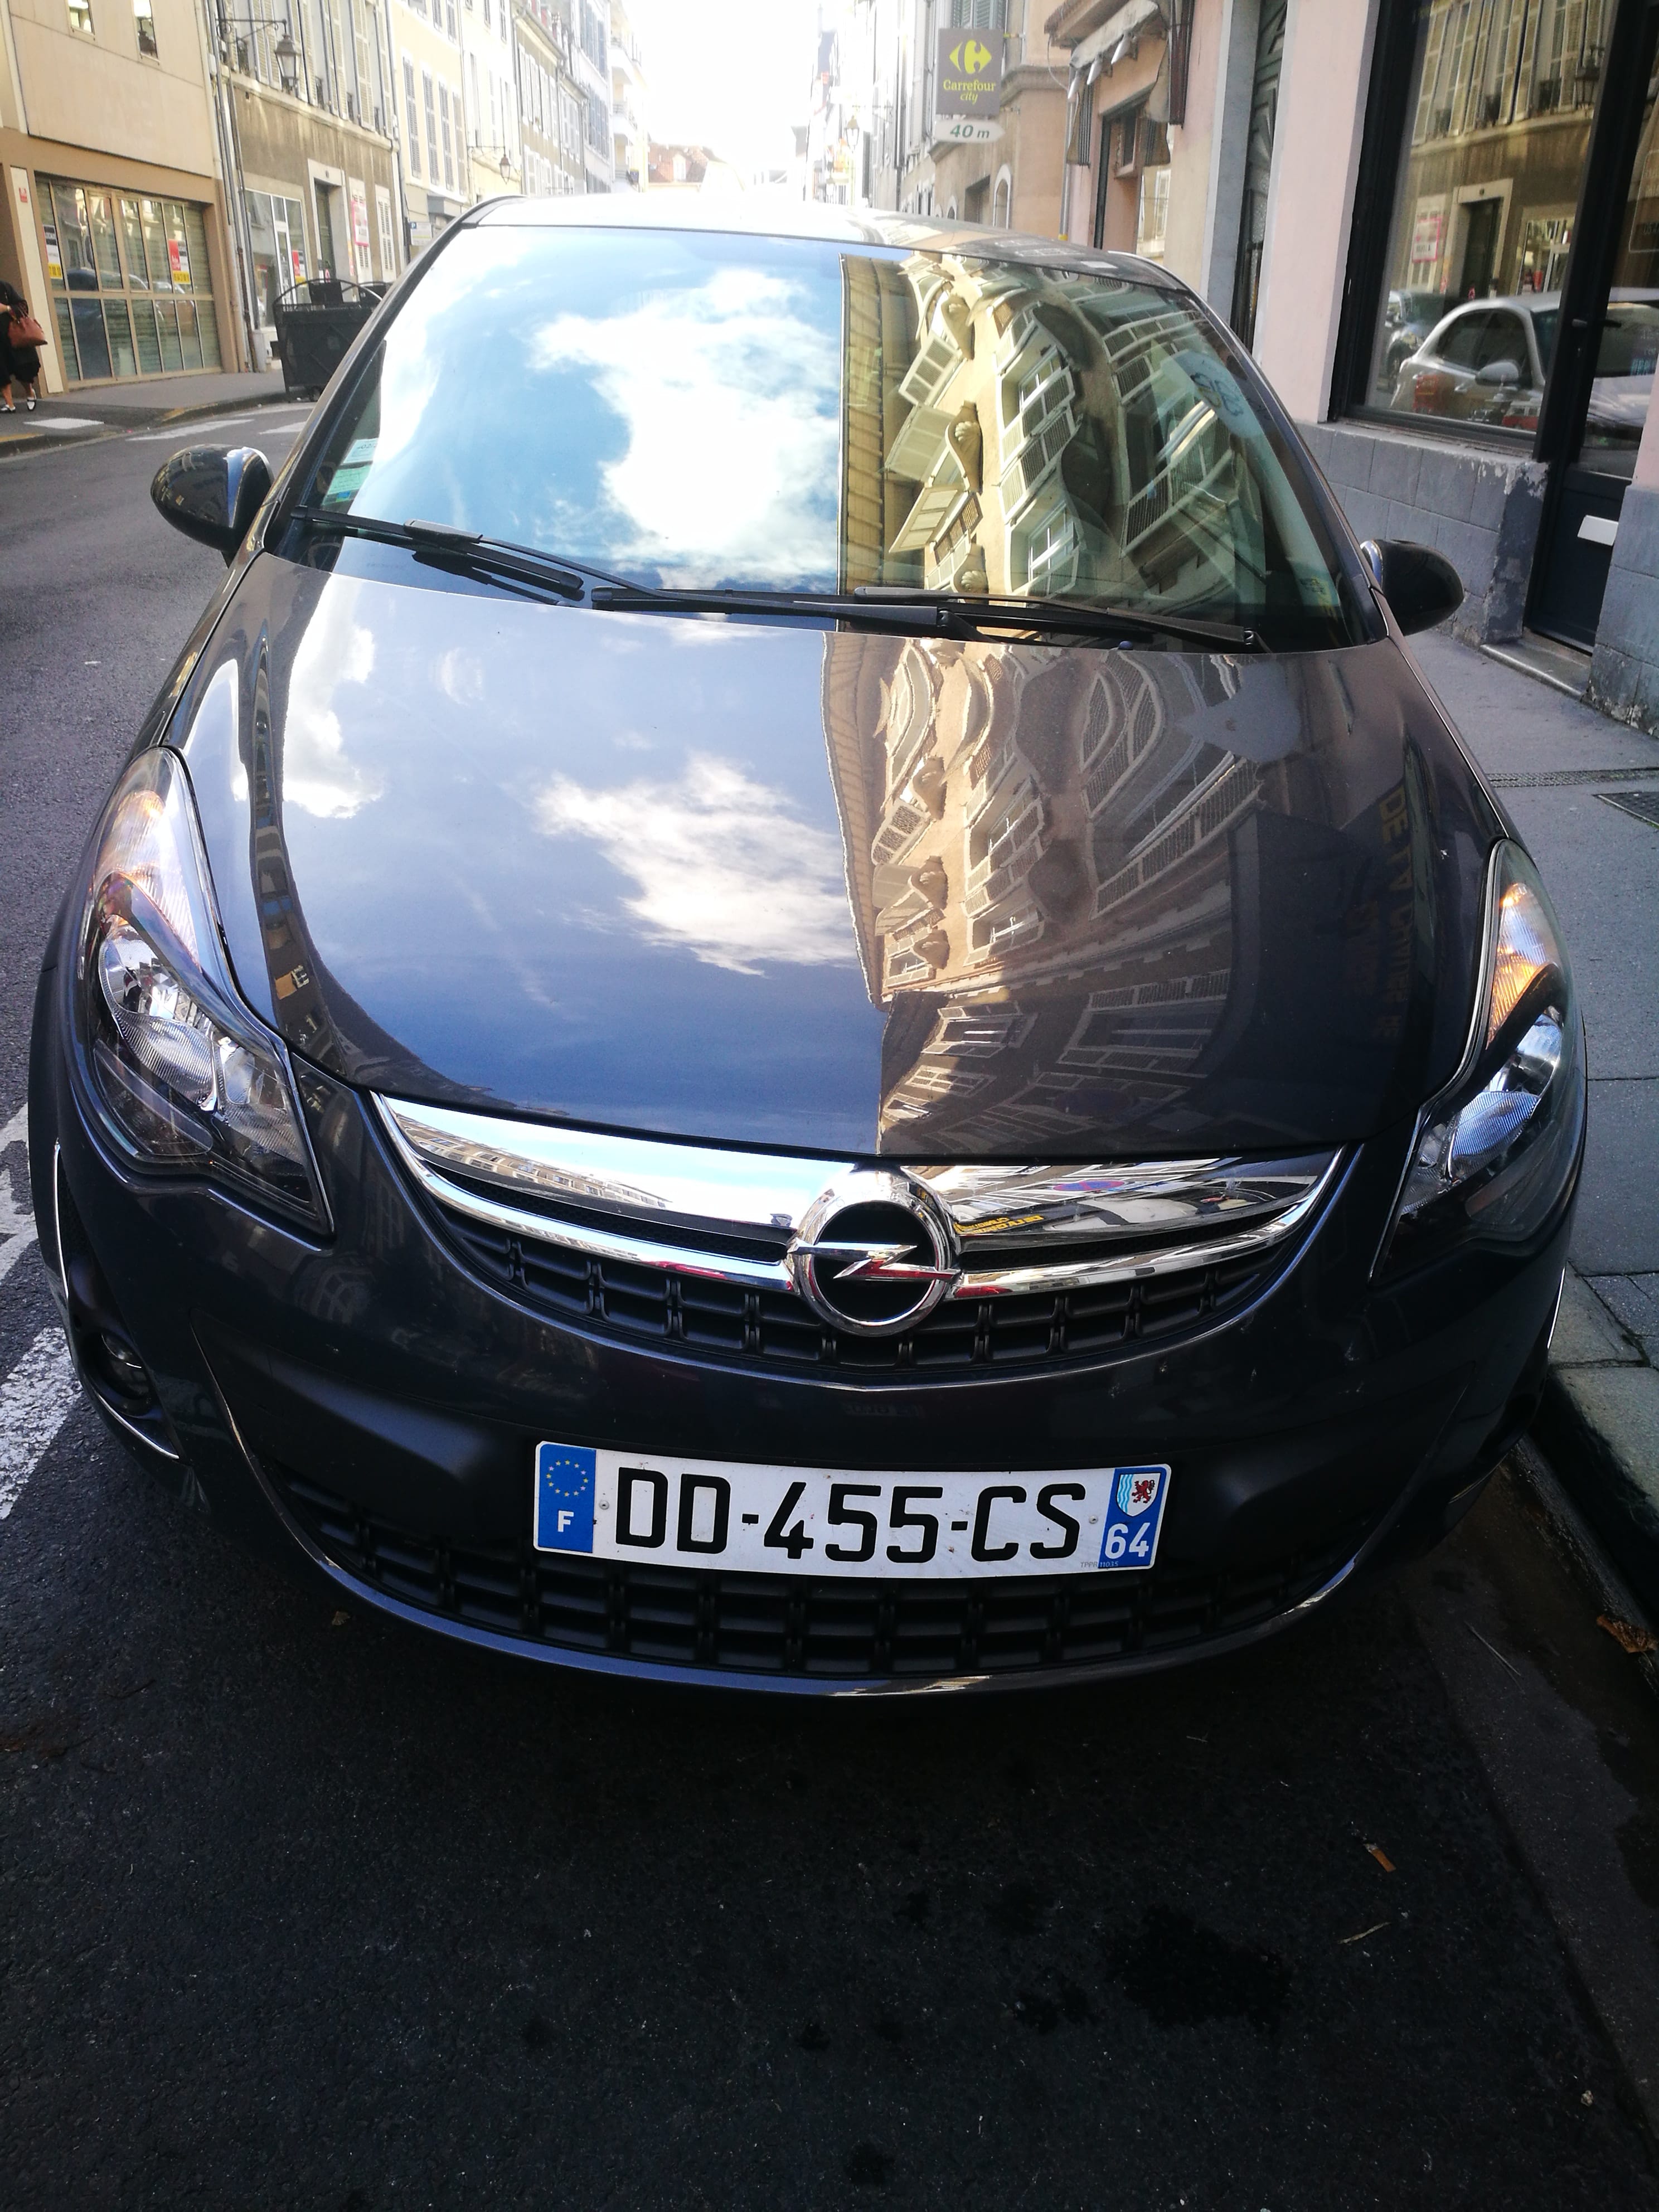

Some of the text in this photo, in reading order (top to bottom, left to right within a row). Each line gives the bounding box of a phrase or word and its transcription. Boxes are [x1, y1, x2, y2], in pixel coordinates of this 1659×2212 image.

[943, 79, 996, 91] Carrefour
[960, 91, 978, 105] city
[950, 124, 989, 138] 40 m
[557, 1510, 574, 1532] F
[615, 1467, 1086, 1564] DD-455-CS
[1105, 1522, 1150, 1559] 64
